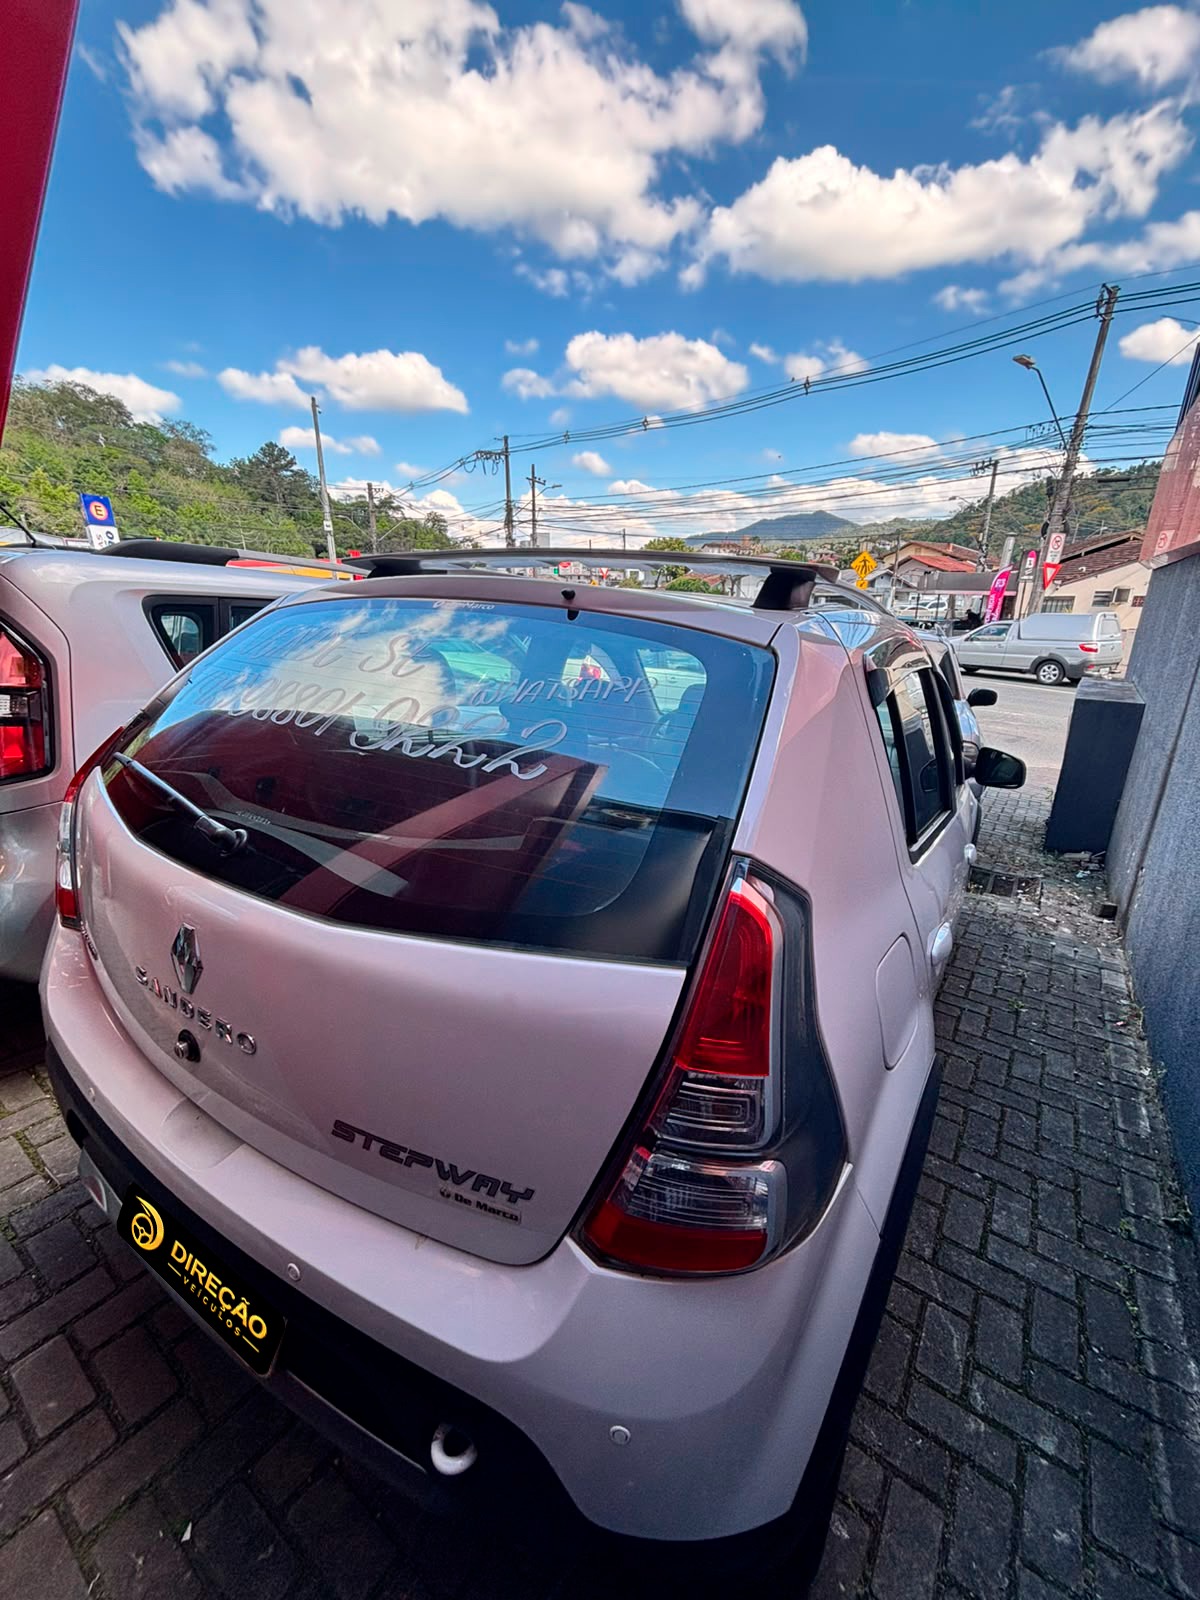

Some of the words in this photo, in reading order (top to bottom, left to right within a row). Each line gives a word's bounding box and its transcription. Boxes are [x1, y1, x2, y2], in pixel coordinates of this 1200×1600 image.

[135, 965, 257, 1055] SANDERO
[331, 1119, 535, 1204] STEPWAY
[454, 1192, 472, 1206] De
[476, 1200, 519, 1222] Marco
[171, 1240, 268, 1339] DIREÇÃO
[183, 1276, 241, 1336] VEÍCULOS
